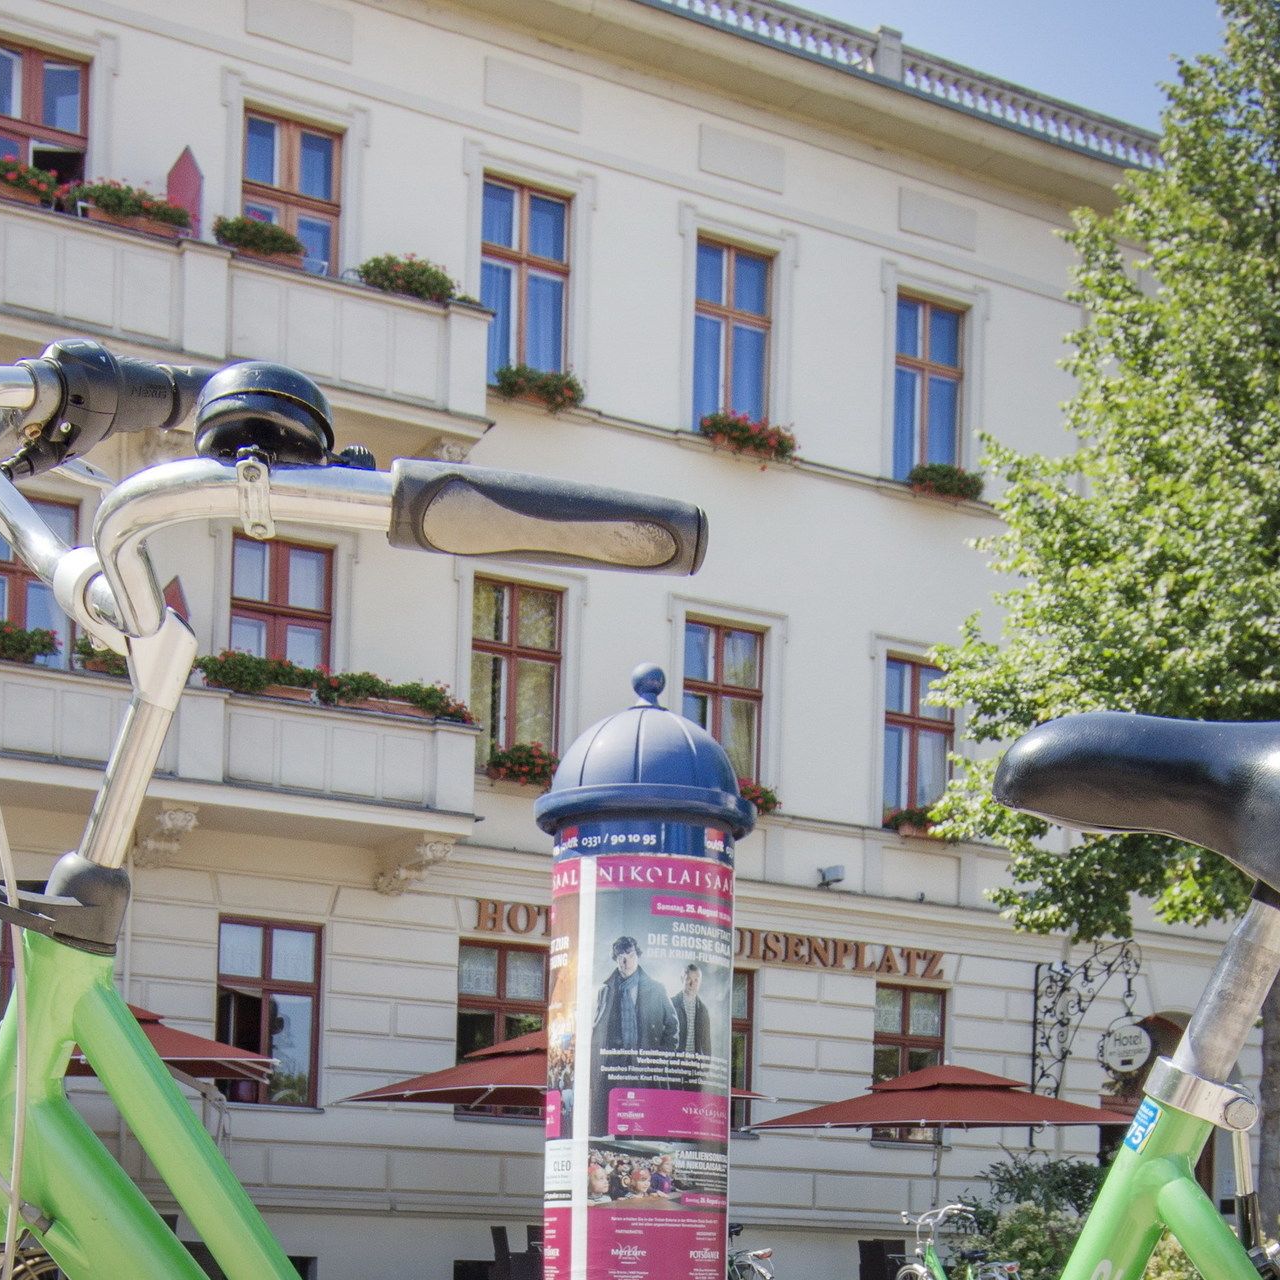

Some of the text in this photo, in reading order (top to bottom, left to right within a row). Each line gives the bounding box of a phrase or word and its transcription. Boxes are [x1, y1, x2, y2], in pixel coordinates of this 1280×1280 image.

[582, 835, 602, 847] 0331
[611, 834, 626, 844] 90
[628, 833, 640, 843] 10
[642, 834, 657, 845] 95
[475, 899, 552, 938] HOT
[647, 933, 668, 947] DIE
[672, 935, 714, 952] GROSSE
[1114, 1030, 1142, 1047] Hotel
